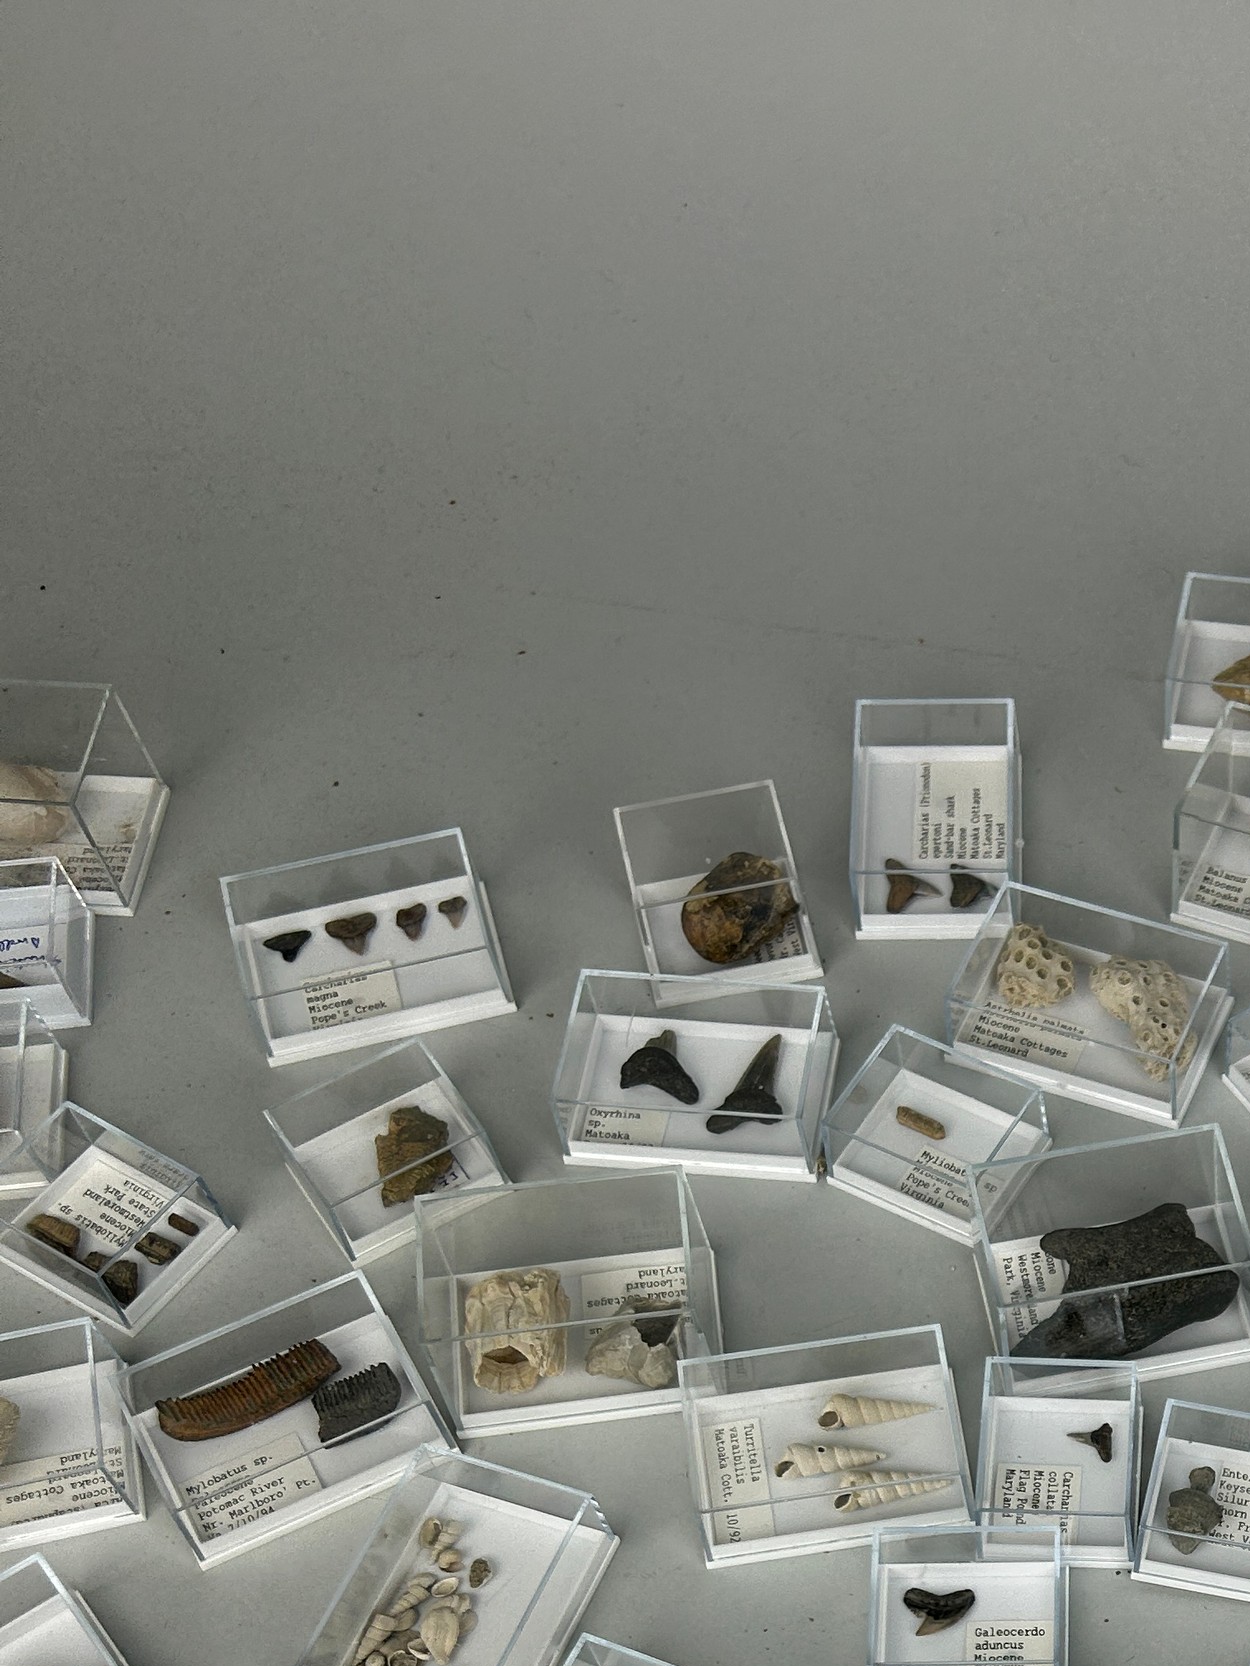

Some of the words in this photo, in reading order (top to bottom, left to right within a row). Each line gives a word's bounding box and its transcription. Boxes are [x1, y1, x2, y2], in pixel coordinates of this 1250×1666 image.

[587, 1119, 605, 1129] sp.
[589, 1107, 641, 1119] Oxyrhina
[584, 1128, 630, 1141] Matoaka
[122, 1179, 165, 1209] Virginia
[897, 1181, 944, 1211] Virginia
[904, 1172, 942, 1194] Pope's
[81, 1187, 146, 1230] Westmoreland
[98, 1211, 135, 1239] Miocene
[1001, 1255, 1015, 1285] Park,
[1029, 1251, 1046, 1292] Miocene
[728, 1425, 745, 1484] varaibilis
[742, 1422, 761, 1482] Turritella
[5, 1484, 64, 1504] Cottages
[196, 1493, 245, 1521] Potomac
[248, 1476, 284, 1497] River
[974, 1625, 1045, 1637] Galeocerdo
[974, 1640, 1024, 1651] aduncus
